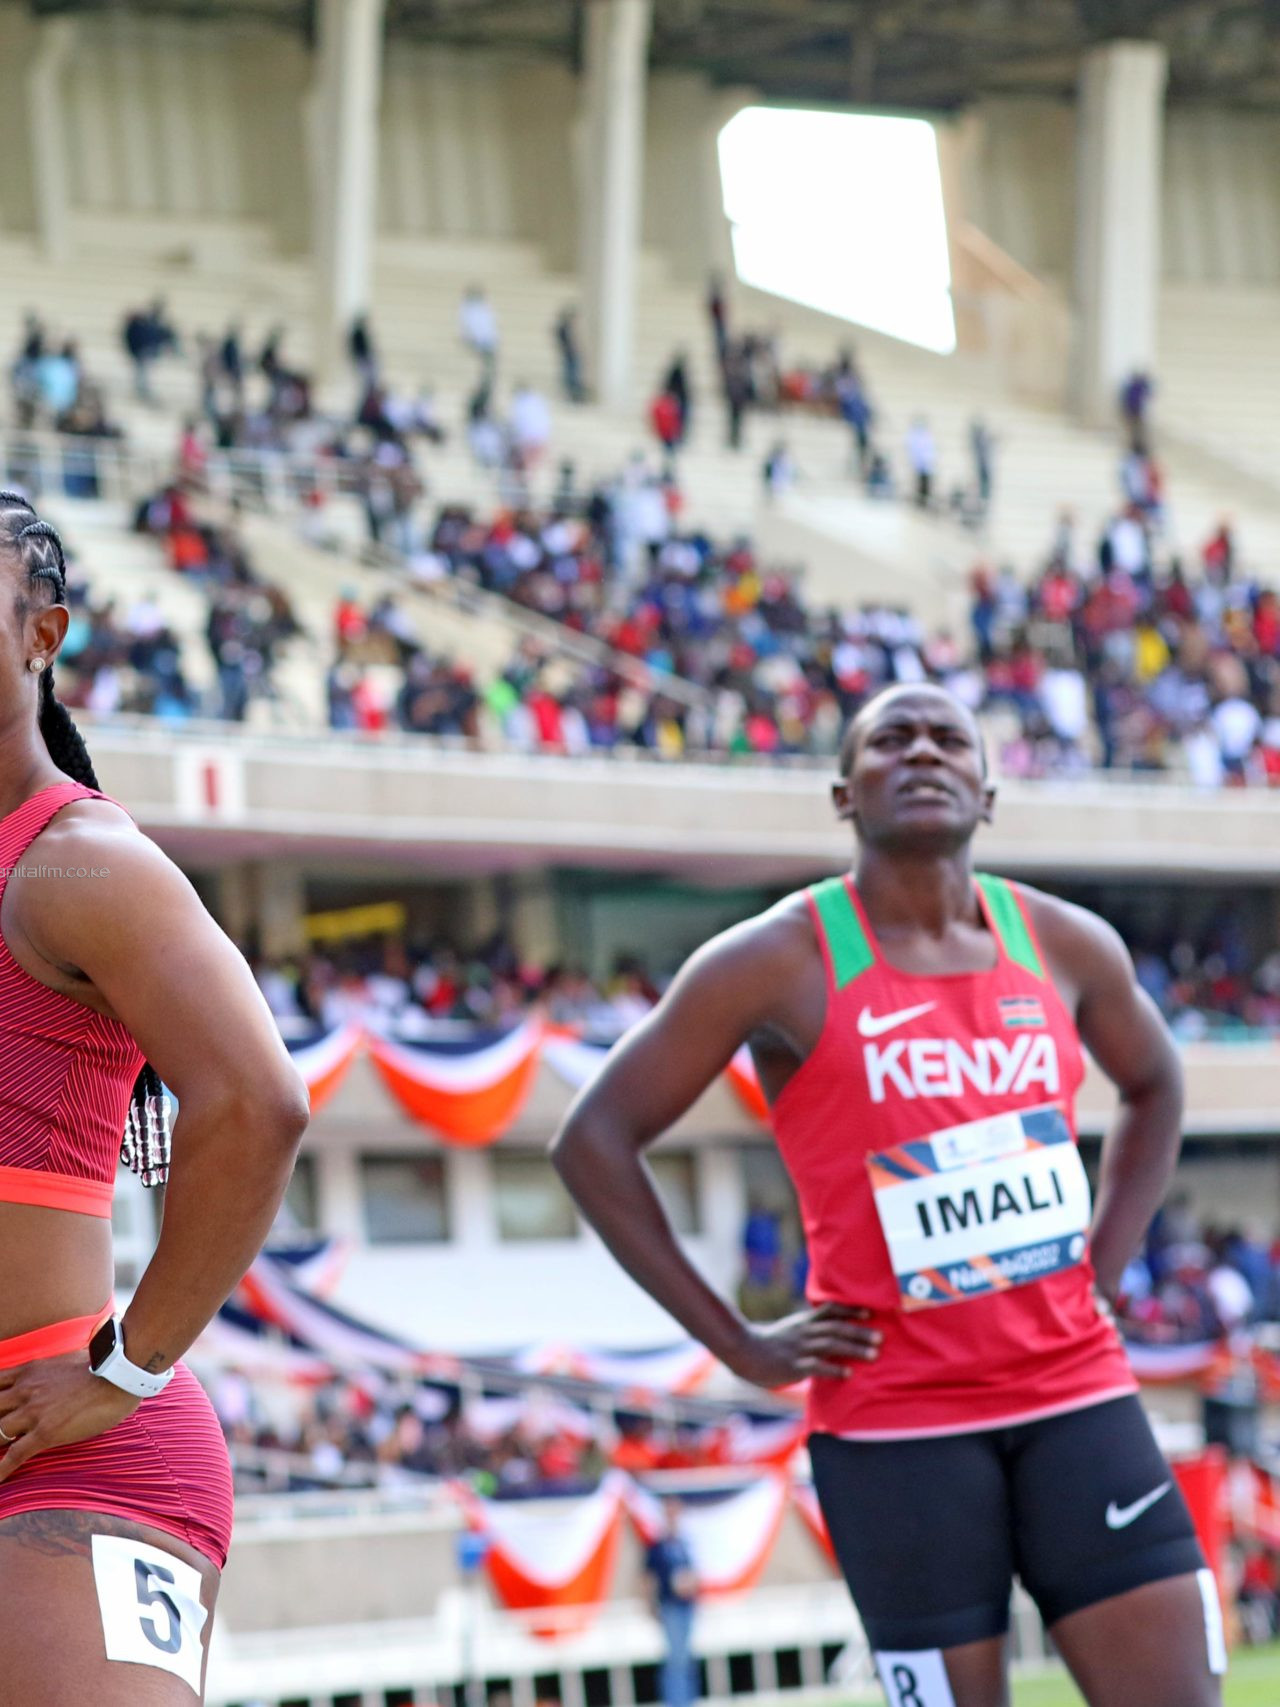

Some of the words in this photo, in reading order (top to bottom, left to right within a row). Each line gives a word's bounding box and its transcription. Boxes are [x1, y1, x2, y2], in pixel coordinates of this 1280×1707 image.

[863, 1033, 1061, 1103] KENYA
[915, 1170, 1065, 1239] IMALI
[134, 1558, 182, 1655] 5
